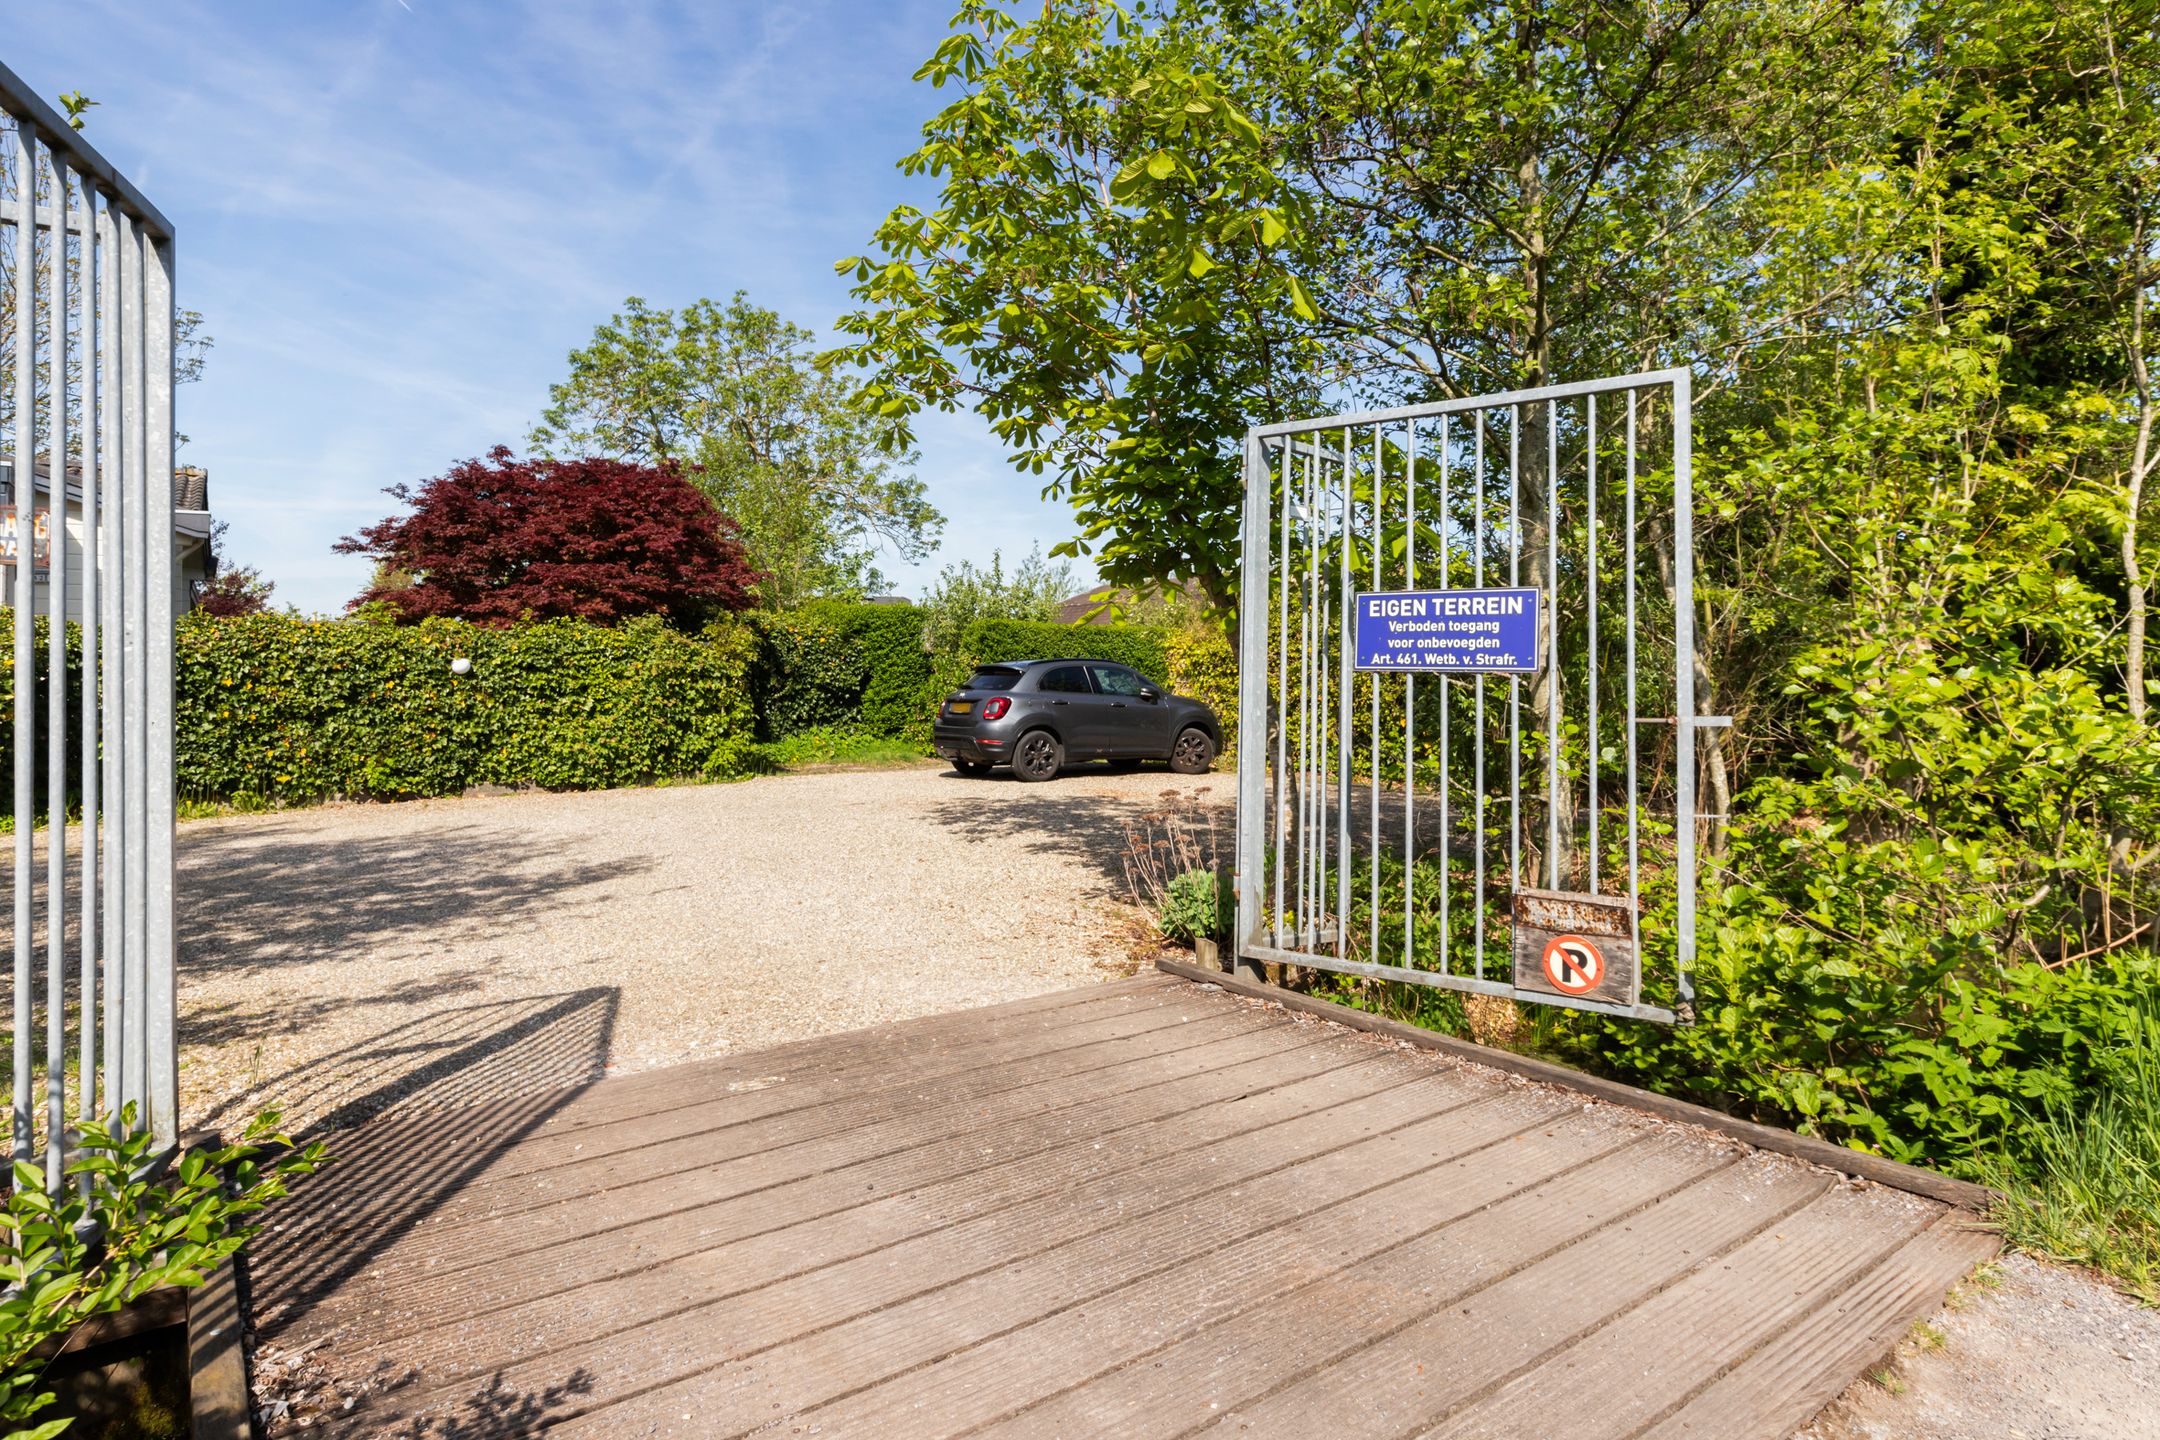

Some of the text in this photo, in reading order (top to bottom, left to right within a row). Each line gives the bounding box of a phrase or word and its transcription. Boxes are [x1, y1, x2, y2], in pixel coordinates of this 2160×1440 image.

[1370, 596, 1523, 617] EIGEN TERREIN
[1389, 620, 1500, 633] Verboden toegang
[1388, 636, 1500, 651] voor onbevoegden
[1370, 653, 1518, 665] Art. 461. Wetb. v. Strafr.
[1562, 948, 1588, 983] P
